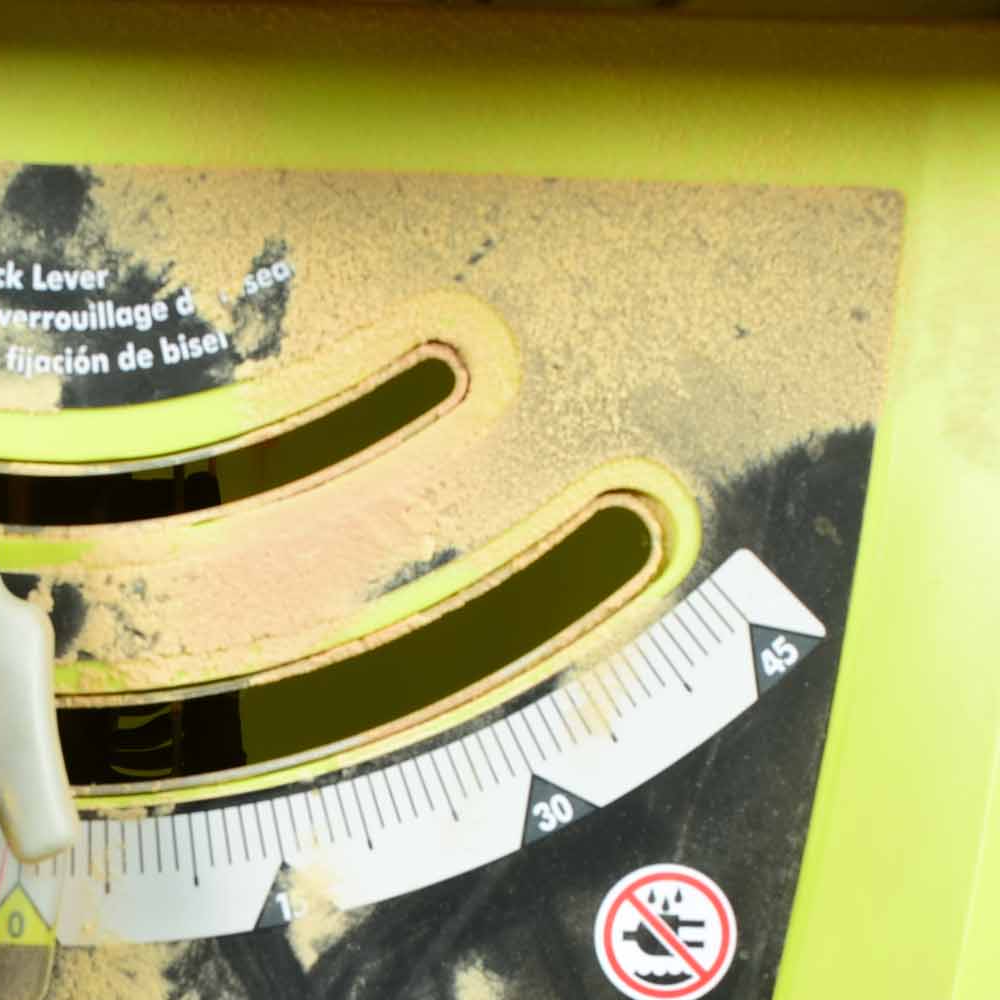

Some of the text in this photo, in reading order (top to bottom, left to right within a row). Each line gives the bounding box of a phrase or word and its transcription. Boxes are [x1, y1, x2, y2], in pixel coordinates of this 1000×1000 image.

[32, 262, 109, 294] Lever
[4, 345, 109, 378] fijación
[118, 341, 153, 372] de
[162, 331, 229, 366] bisel
[760, 635, 799, 677] 45
[532, 793, 574, 833] 30
[8, 911, 25, 940] 0
